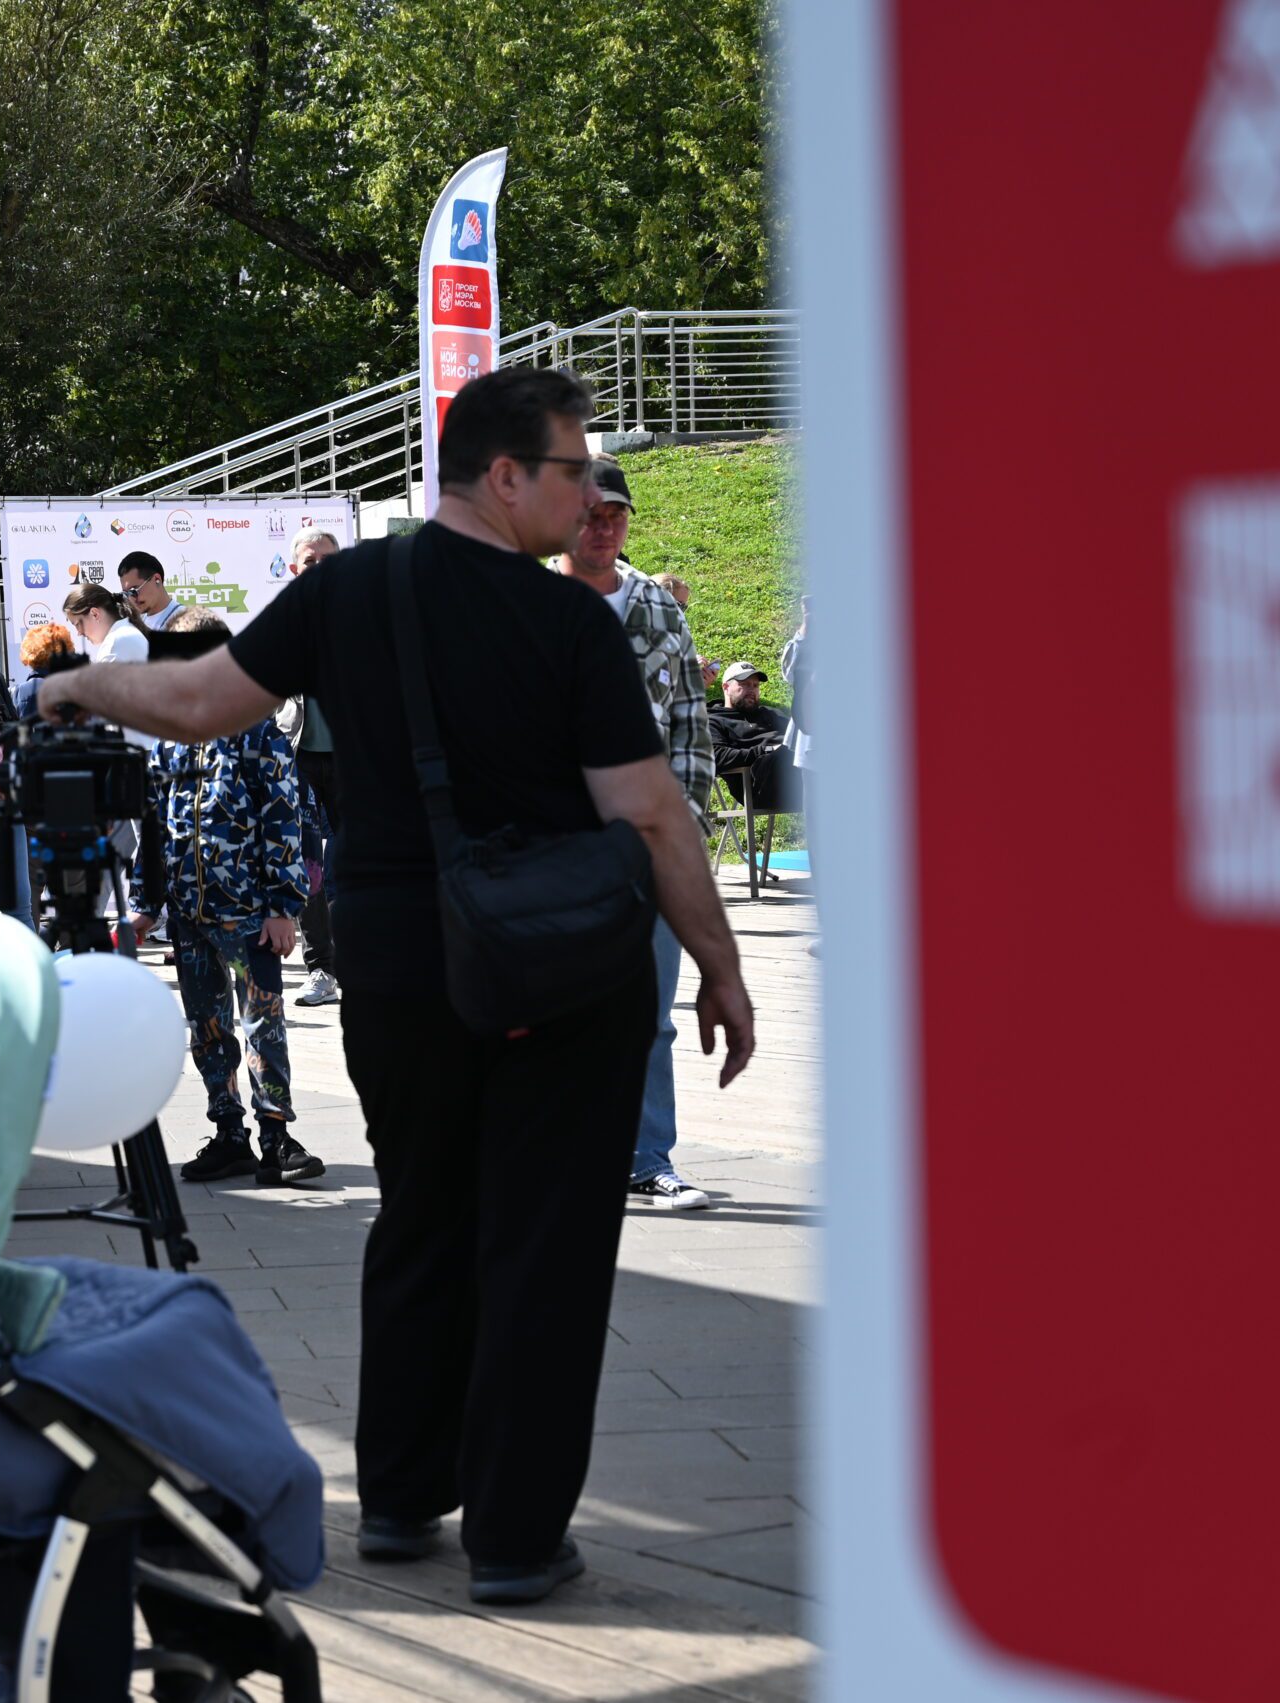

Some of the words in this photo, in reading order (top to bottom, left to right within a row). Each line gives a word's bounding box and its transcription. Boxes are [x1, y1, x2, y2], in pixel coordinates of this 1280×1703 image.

[455, 283, 478, 292] ПРОЕКТ
[455, 291, 474, 300] МЭРА
[454, 299, 482, 309] МОСКВЫ
[127, 523, 155, 531] Сборка
[207, 518, 250, 532] Первые
